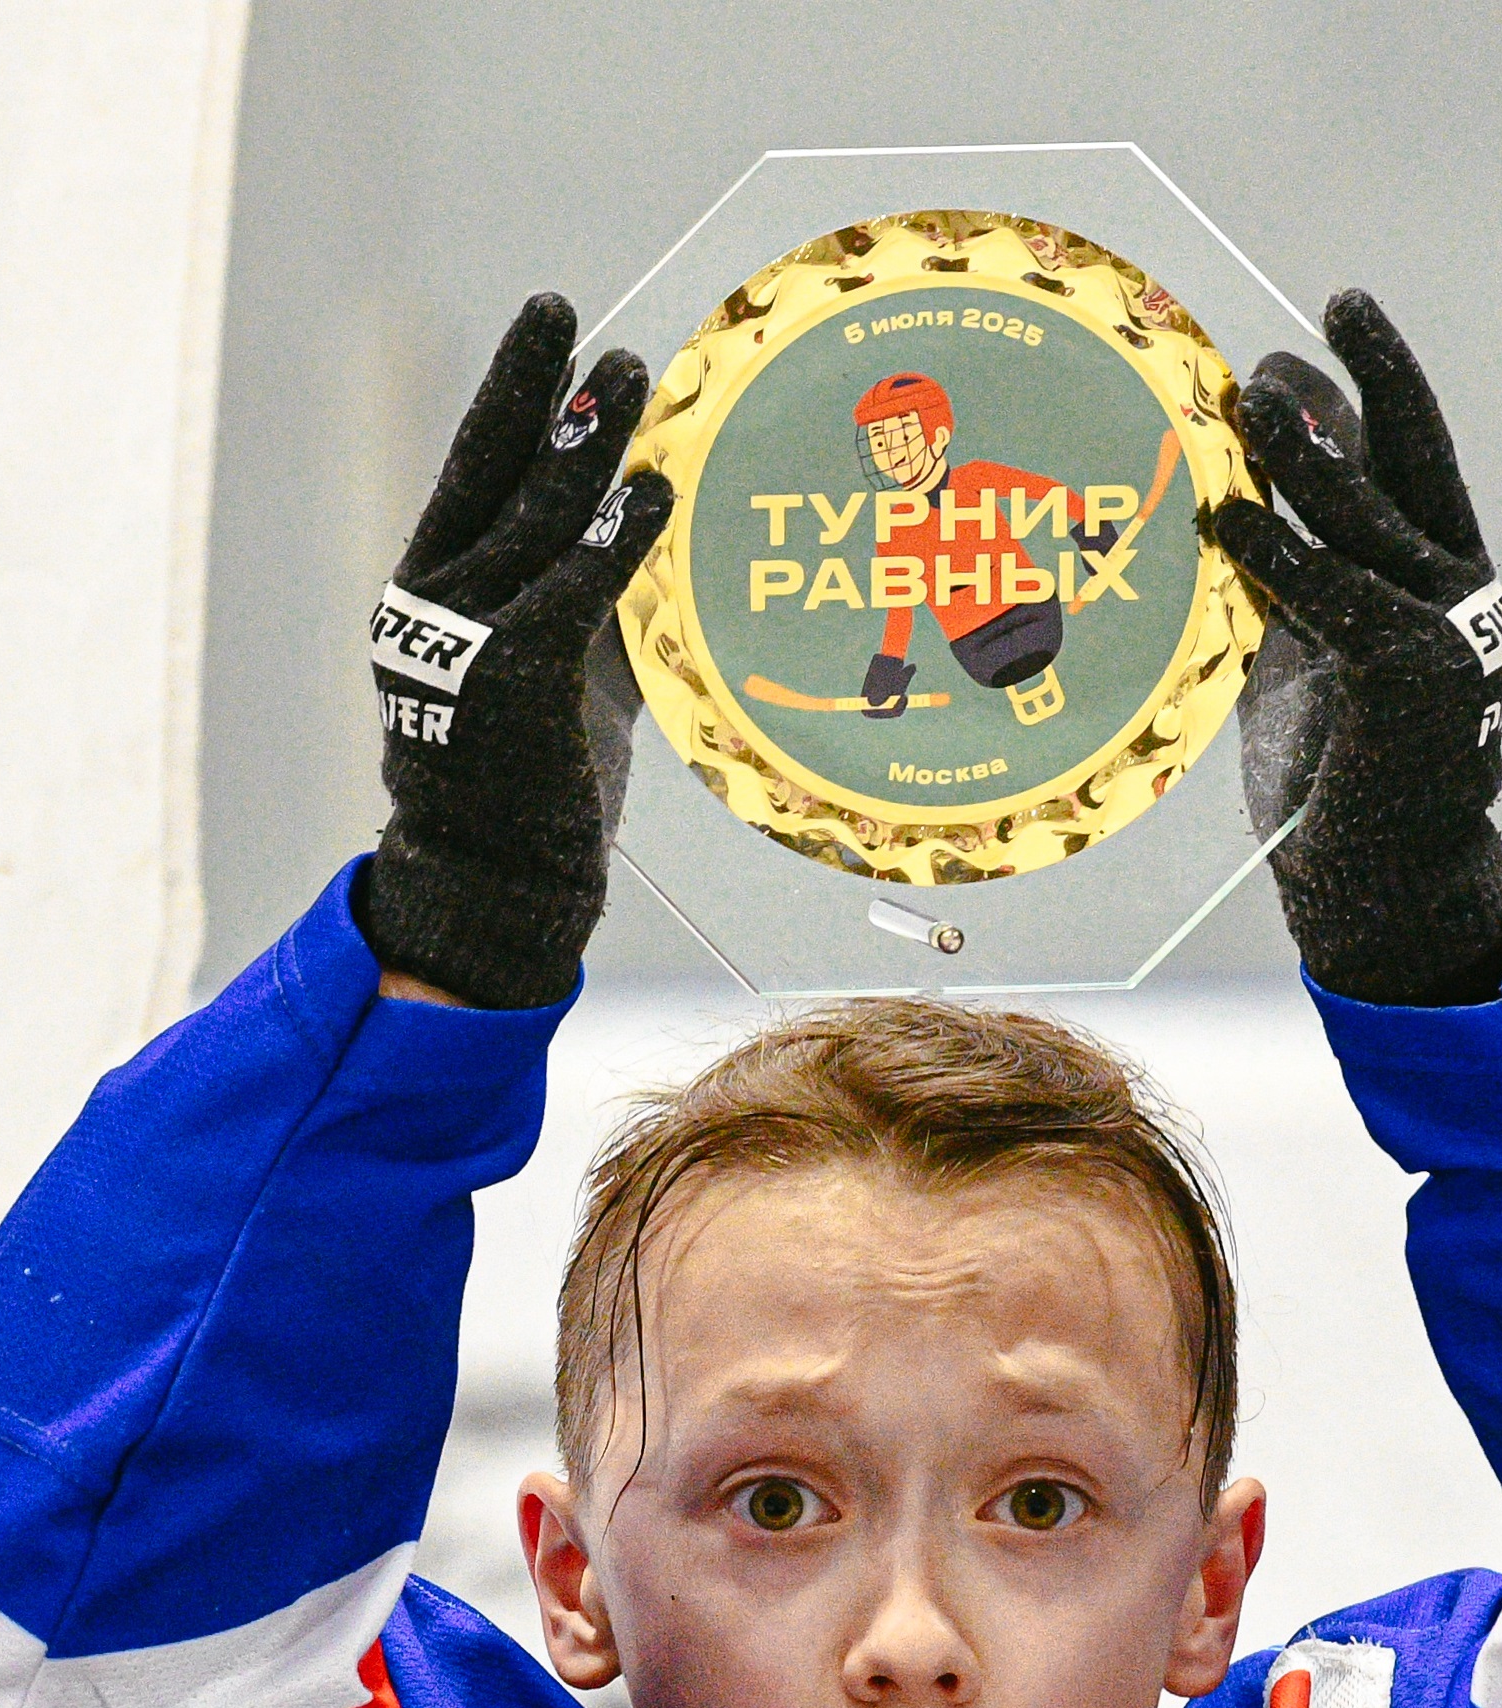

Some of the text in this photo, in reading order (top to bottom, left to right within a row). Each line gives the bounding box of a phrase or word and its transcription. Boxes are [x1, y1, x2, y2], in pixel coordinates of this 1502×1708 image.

[843, 307, 1046, 347] 5 июля 2025
[749, 484, 1141, 546] ТУРНИР
[749, 548, 1141, 613] РАВНЫХ
[370, 602, 473, 672] PER
[887, 757, 1009, 786] Москва
